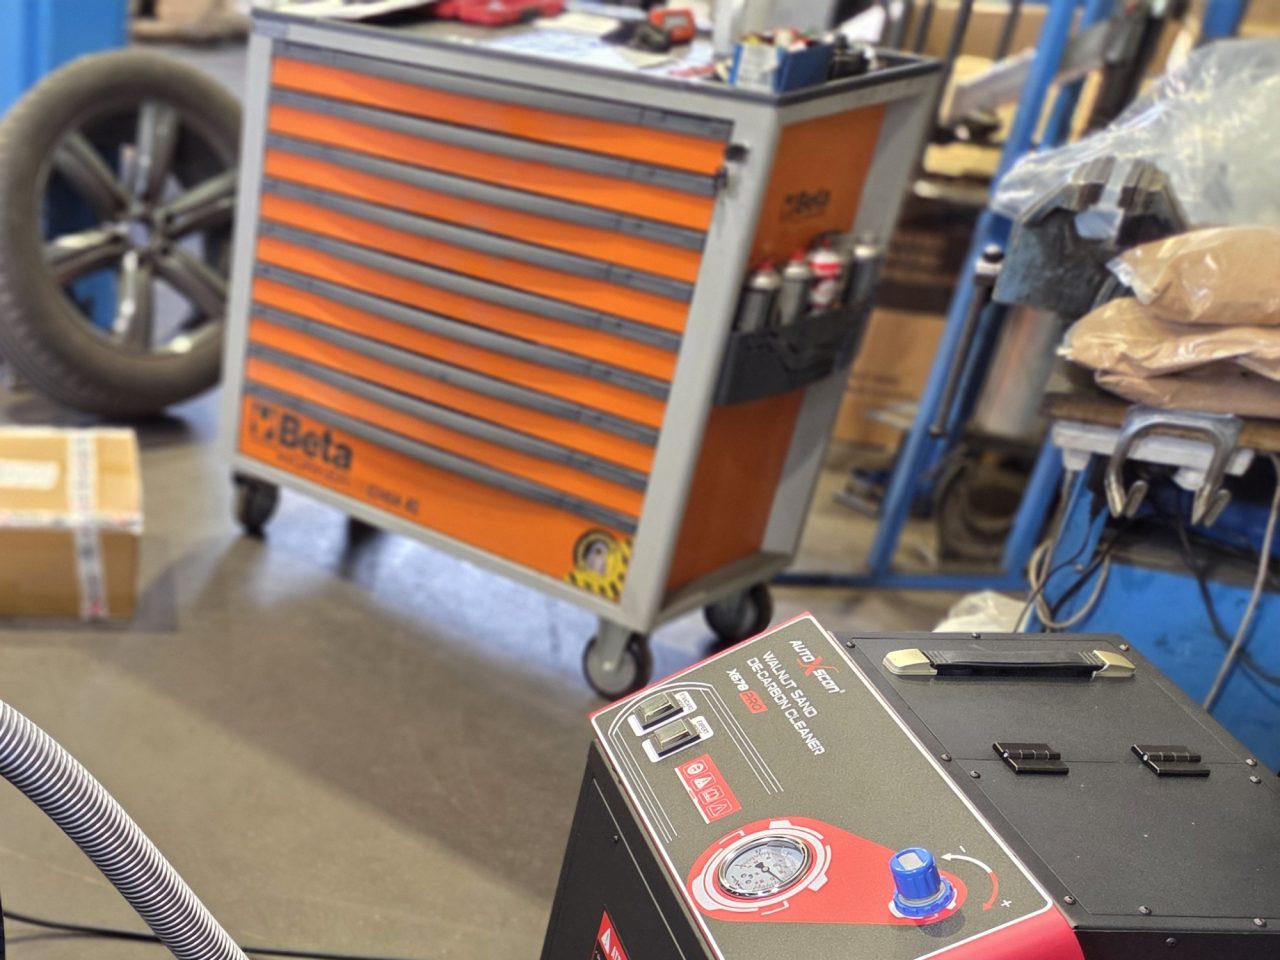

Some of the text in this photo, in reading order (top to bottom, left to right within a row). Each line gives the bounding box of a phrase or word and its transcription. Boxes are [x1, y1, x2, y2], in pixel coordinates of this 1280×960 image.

[279, 413, 352, 469] Beta
[746, 657, 826, 755] DE-CARBON CLEANER
[762, 650, 818, 718] WALNUT SAND
